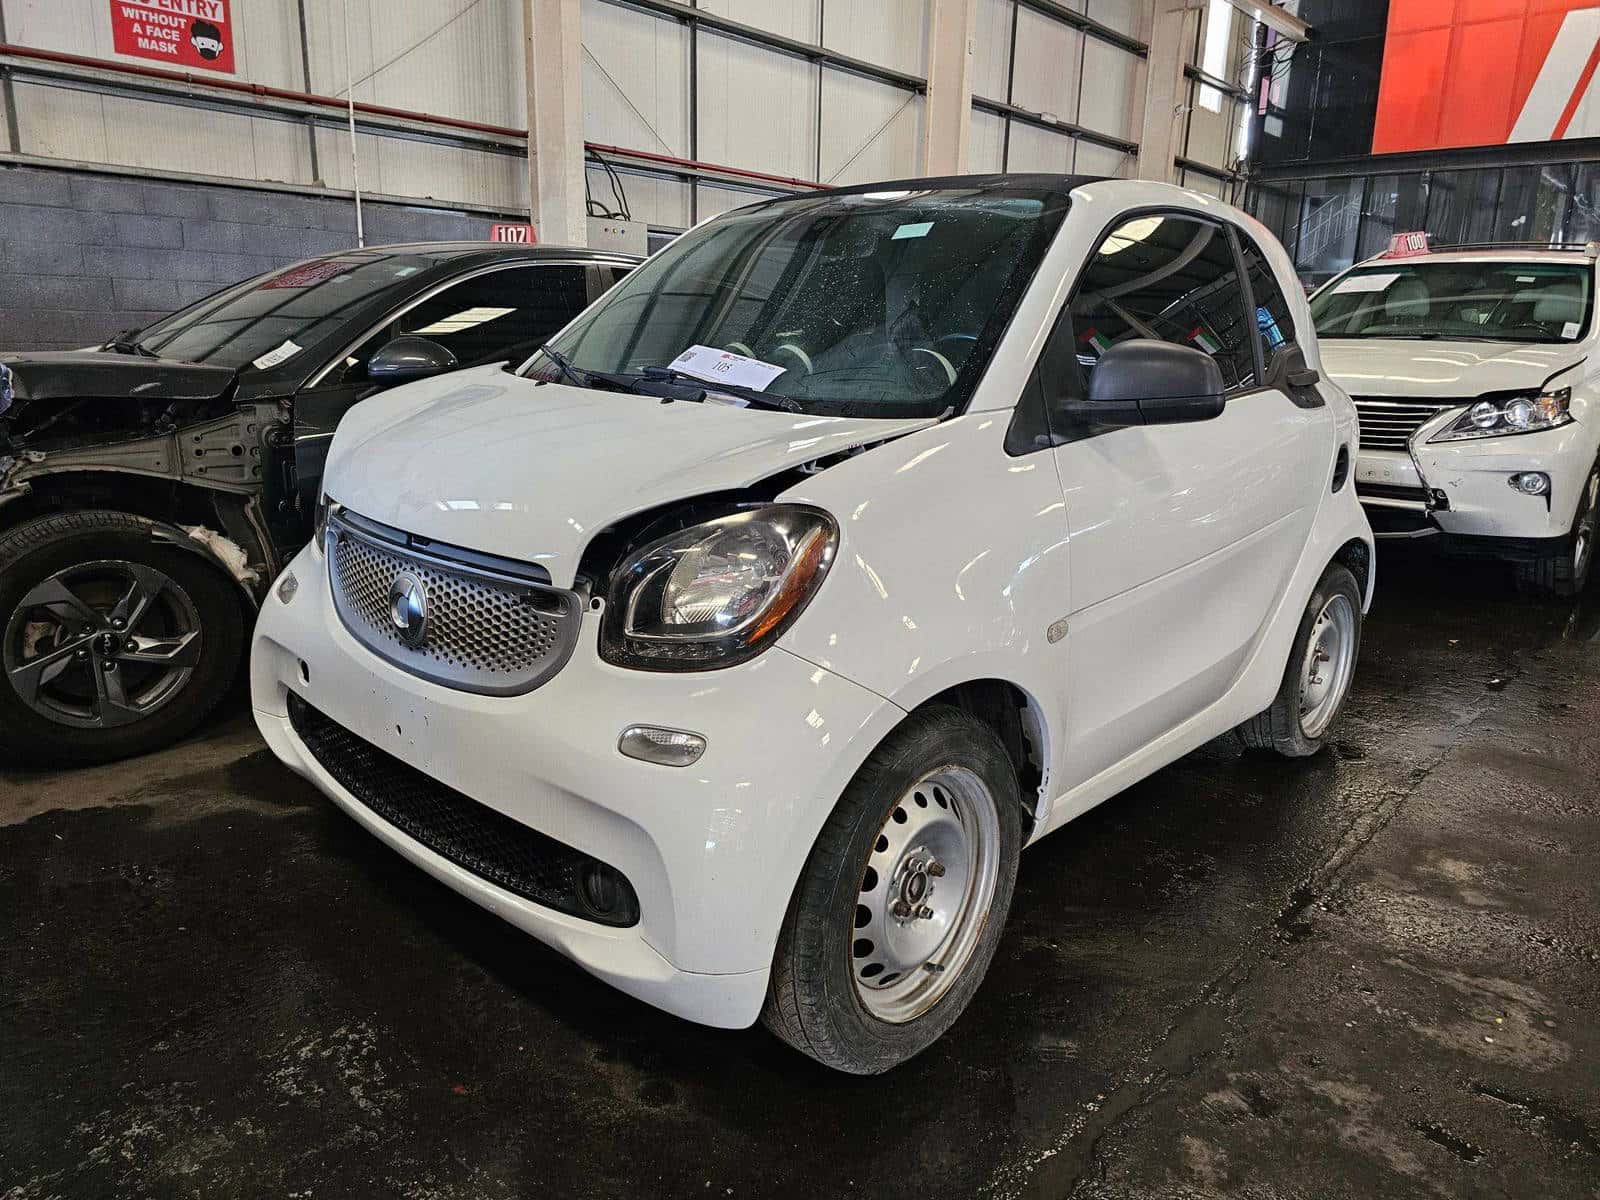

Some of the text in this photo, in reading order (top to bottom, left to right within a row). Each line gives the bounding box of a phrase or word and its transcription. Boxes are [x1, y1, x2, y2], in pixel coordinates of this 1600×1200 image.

[121, 6, 187, 29] WITHOUT
[132, 23, 181, 41] A FACE
[137, 37, 178, 55] MASK
[499, 226, 526, 243] 107
[1406, 234, 1424, 250] 100
